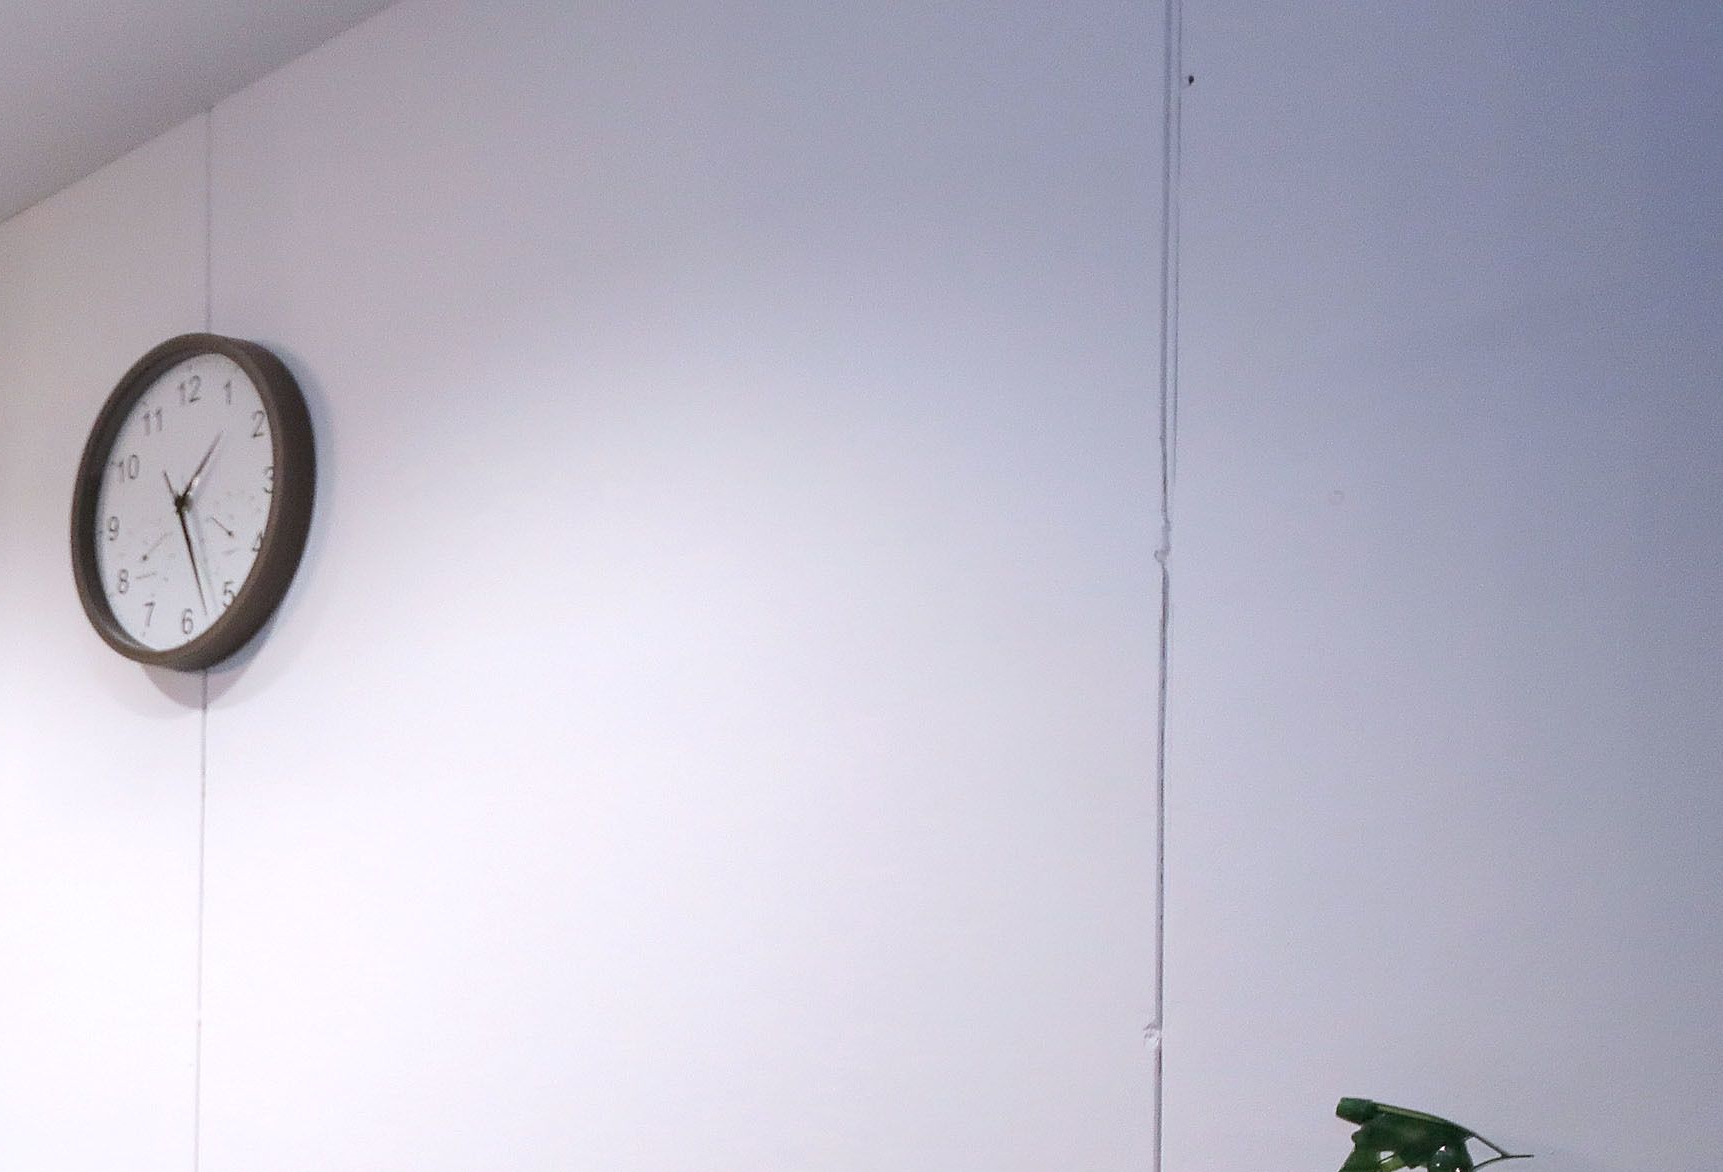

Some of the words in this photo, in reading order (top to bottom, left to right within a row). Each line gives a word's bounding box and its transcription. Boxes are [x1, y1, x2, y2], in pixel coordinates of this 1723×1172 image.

[179, 375, 202, 403] 12
[224, 380, 233, 405] 1
[143, 408, 164, 436] 11
[251, 409, 266, 439] 2
[115, 454, 140, 484] 10
[107, 516, 120, 542] 9
[117, 568, 130, 595] 8
[143, 601, 156, 628] 7
[182, 608, 194, 635] 6
